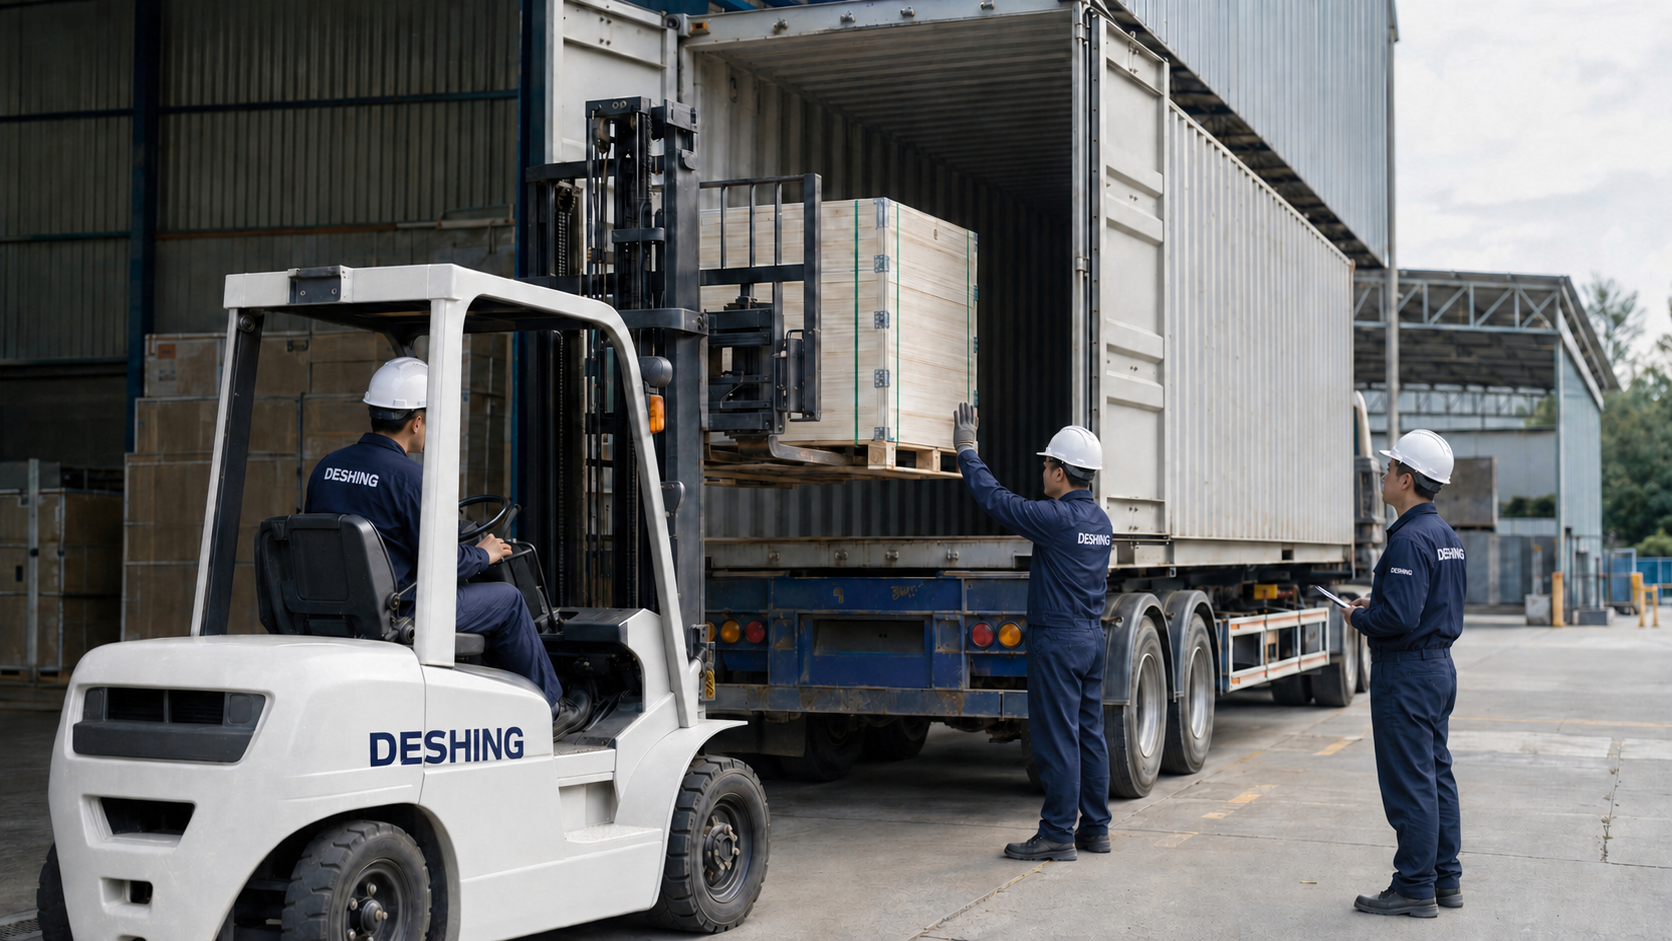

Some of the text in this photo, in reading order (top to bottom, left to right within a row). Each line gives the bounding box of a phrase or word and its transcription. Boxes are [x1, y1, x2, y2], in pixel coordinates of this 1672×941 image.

[324, 467, 379, 487] DESHING
[1077, 532, 1110, 546] DESHING
[369, 726, 525, 767] DESHING
